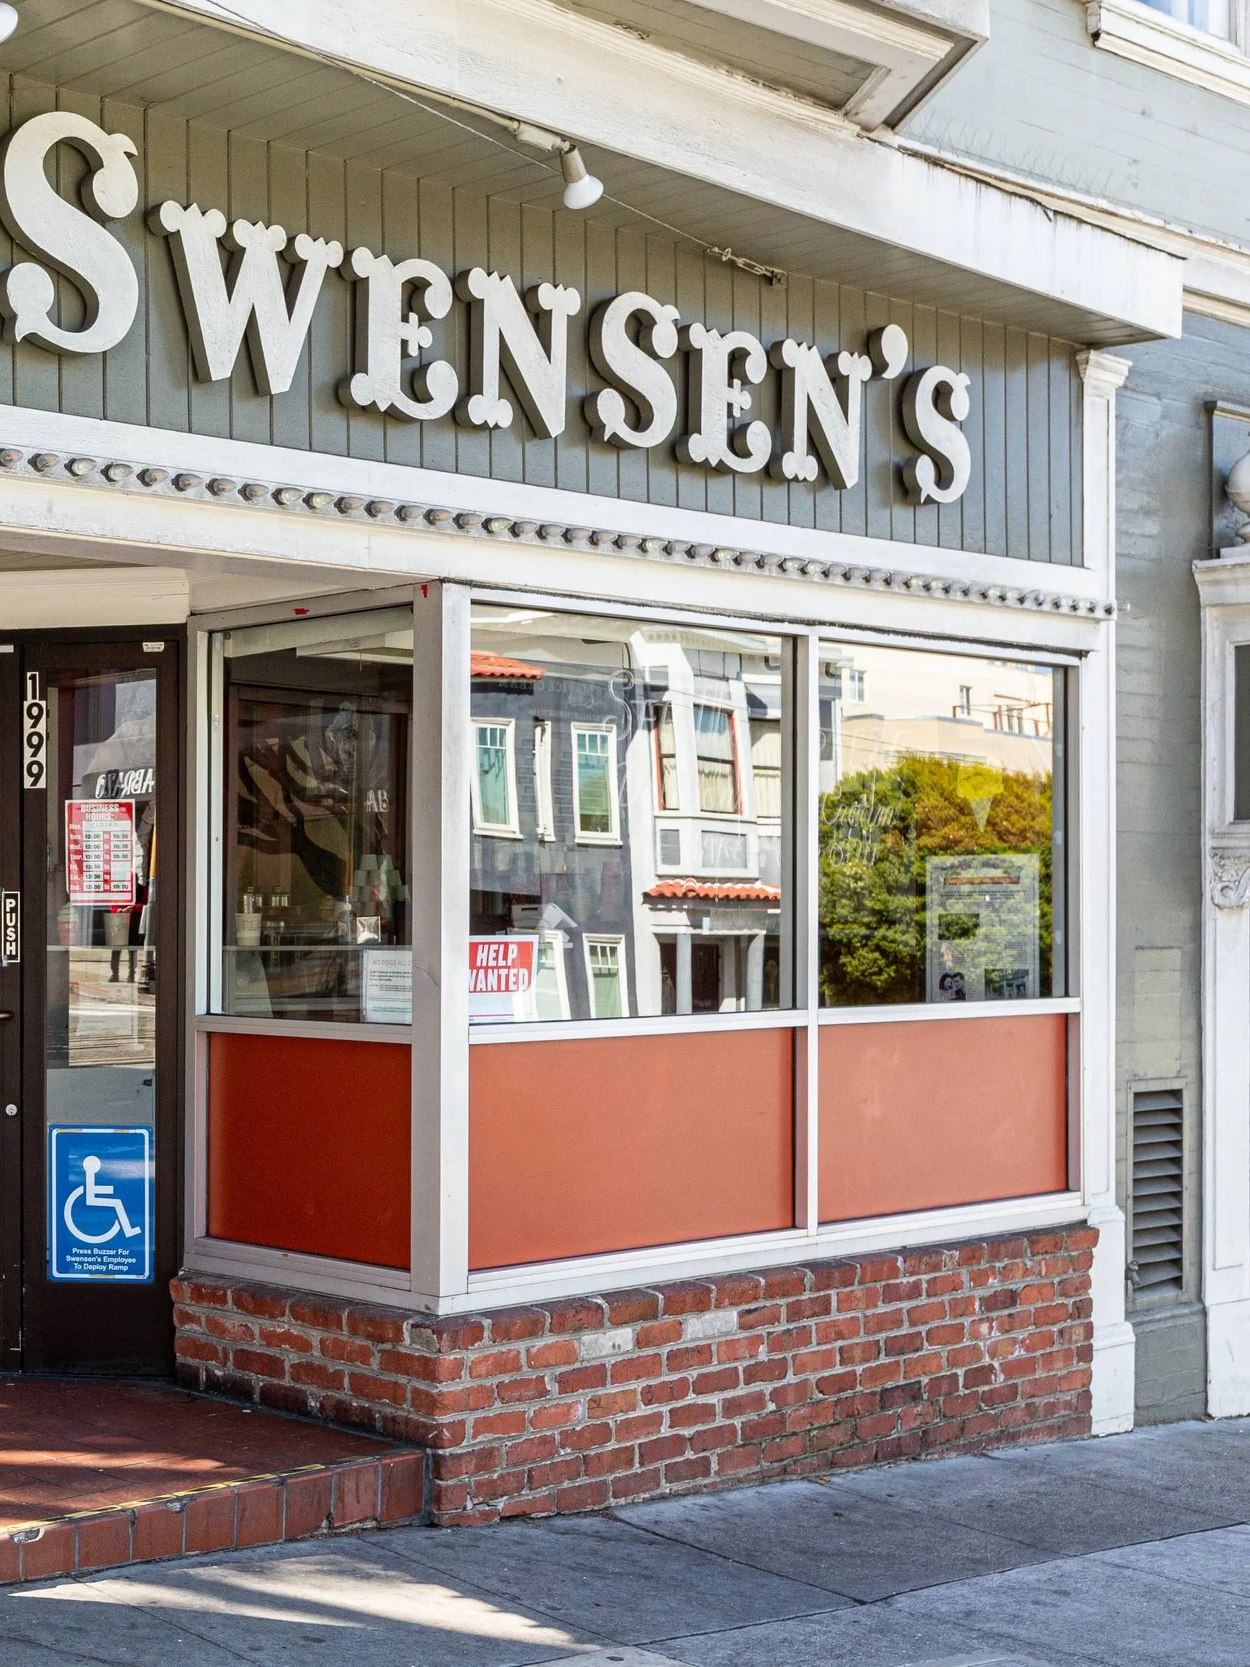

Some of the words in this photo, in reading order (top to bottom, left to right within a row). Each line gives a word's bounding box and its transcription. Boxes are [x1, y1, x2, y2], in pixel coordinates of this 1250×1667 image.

[26, 673, 44, 787] 1999
[80, 804, 119, 812] BUSINESS
[6, 898, 16, 956] PUSH
[476, 944, 518, 967] HELP
